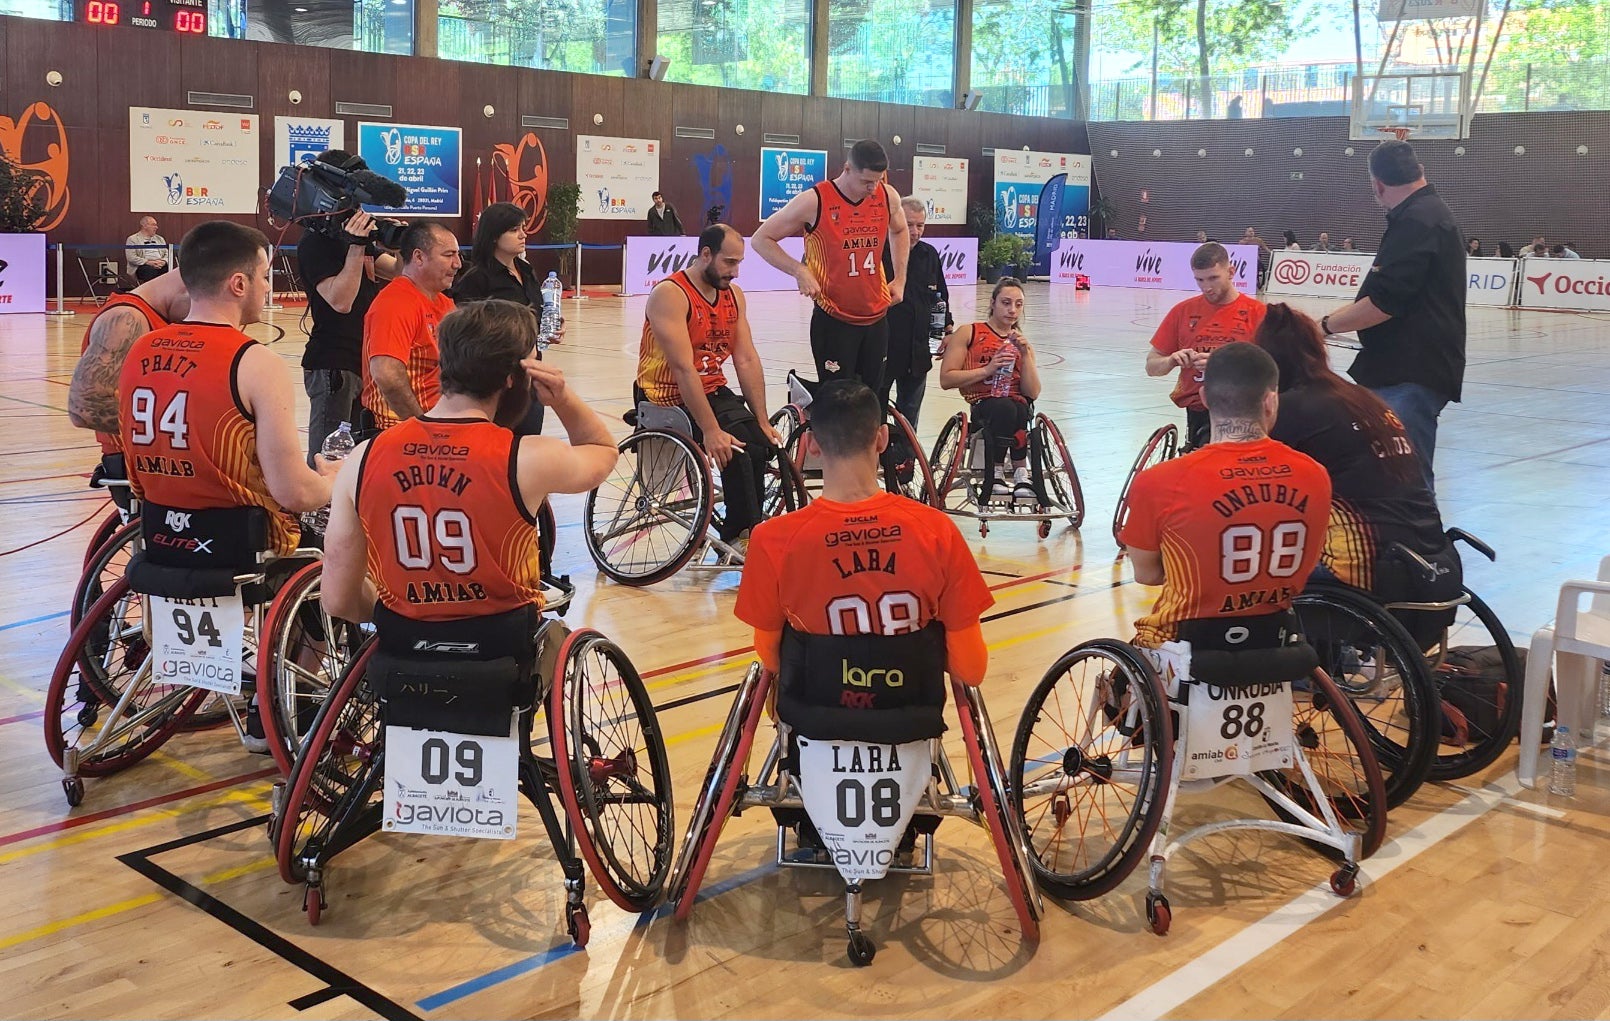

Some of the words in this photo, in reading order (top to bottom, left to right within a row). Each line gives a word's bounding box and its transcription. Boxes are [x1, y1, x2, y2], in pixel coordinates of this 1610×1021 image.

[87, 1, 119, 25] 00
[131, 17, 157, 28] PERIODO
[176, 11, 204, 33] 00
[403, 136, 418, 144] COPA
[419, 137, 430, 145] DEL
[431, 137, 442, 146] REY
[404, 156, 442, 167] ESPAÑA
[1018, 195, 1031, 204] COPA
[1077, 216, 1087, 226] 23
[843, 238, 879, 249] AMIAB
[848, 251, 876, 276] 14
[1315, 263, 1361, 273] Fundación
[1313, 273, 1359, 287] ONCE
[151, 338, 205, 349] gaviota
[140, 354, 197, 378] PRATT
[131, 386, 190, 450] 94
[403, 443, 470, 456] gaviota
[136, 455, 195, 477] AMIAB
[1219, 464, 1292, 480] gaviota
[393, 464, 472, 497] BROWN
[1212, 483, 1310, 518] ONRUBIA
[850, 515, 878, 523] UCLM
[391, 504, 478, 576] 09
[825, 525, 902, 547] gaviota
[1220, 520, 1307, 584] 88
[832, 549, 896, 579] LARA
[406, 582, 488, 604] AMIAB
[825, 590, 922, 636] 08
[172, 608, 222, 648] 94
[163, 660, 234, 682] gaviota
[842, 658, 904, 688] lara
[1220, 702, 1265, 739] 88
[421, 737, 483, 787] 09
[832, 745, 902, 773] LARA
[1192, 750, 1224, 760] amiab
[396, 801, 504, 826] gaviota
[836, 778, 901, 828] 08
[835, 849, 893, 866] avio
